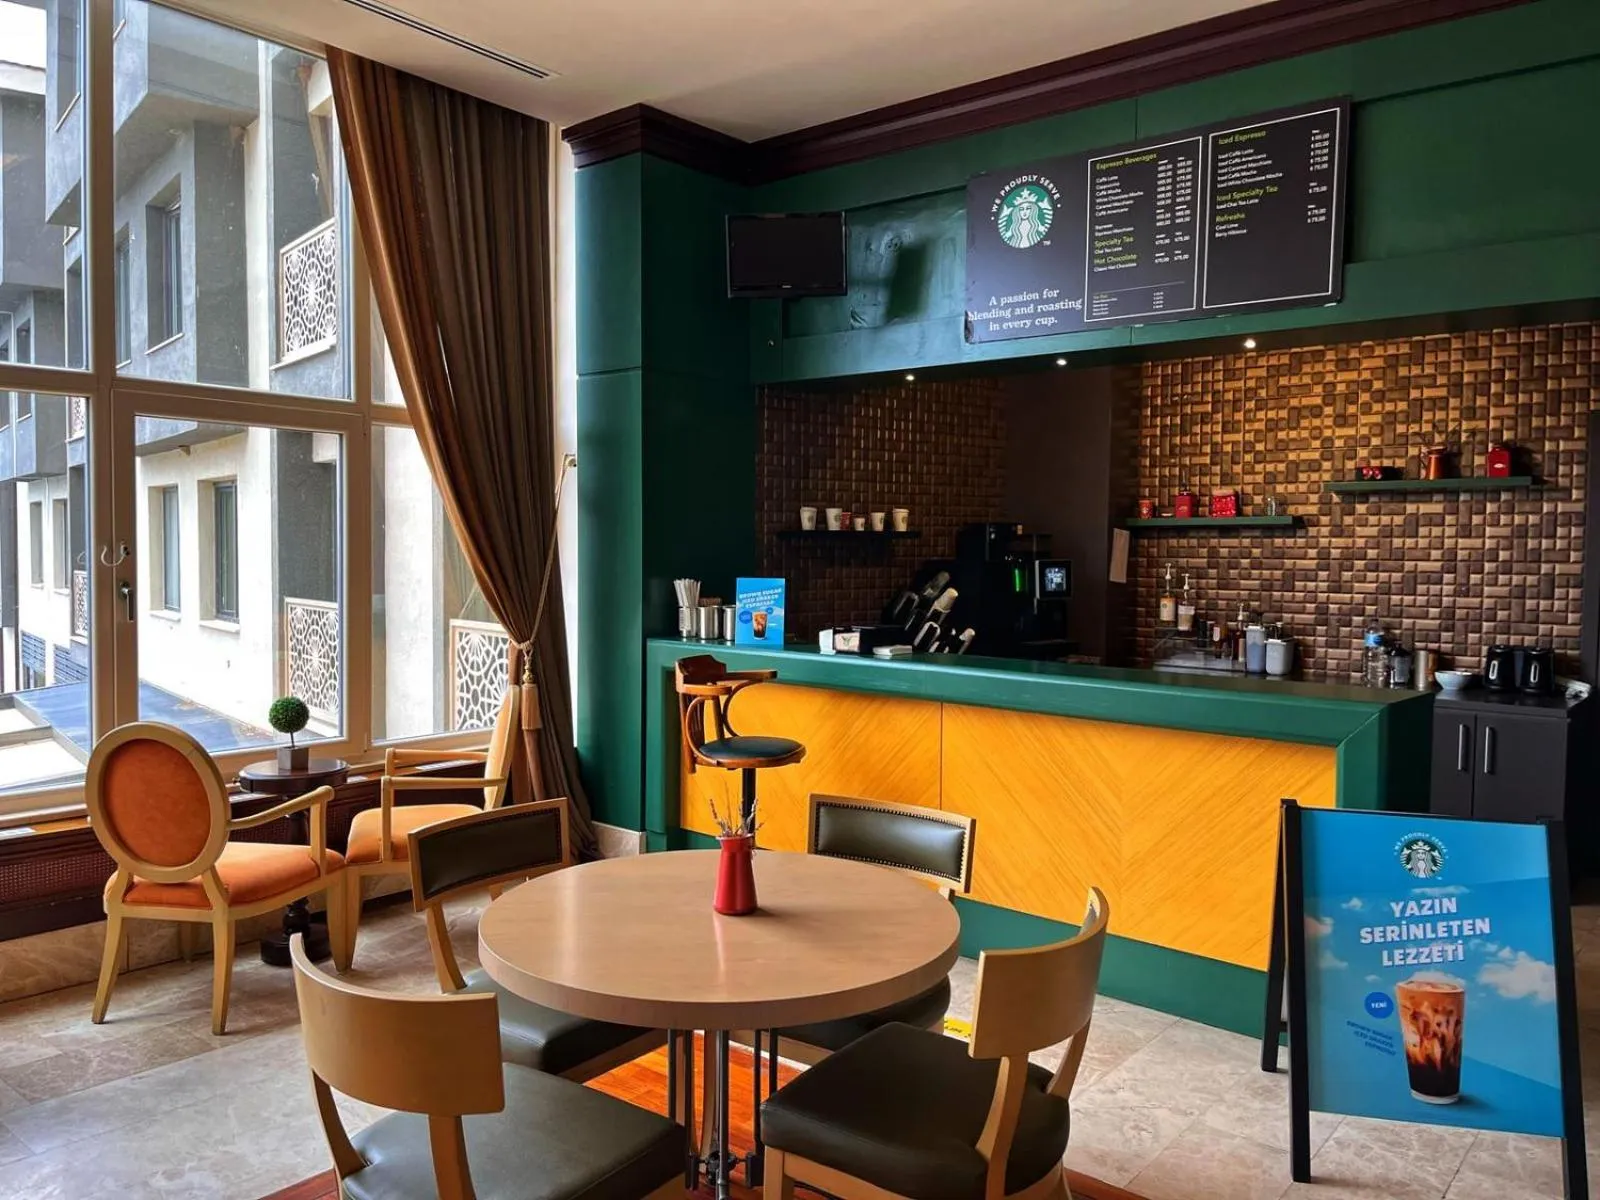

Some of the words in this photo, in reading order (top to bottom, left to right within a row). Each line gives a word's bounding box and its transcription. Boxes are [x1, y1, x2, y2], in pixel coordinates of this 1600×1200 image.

[992, 198, 1001, 213] WE
[1000, 175, 1038, 197] PROUDLY
[1040, 176, 1061, 201] SERVE
[989, 296, 998, 306] A
[1000, 291, 1039, 306] passion
[1042, 288, 1060, 299] for
[1014, 303, 1034, 315] and
[1037, 298, 1083, 313] roasting
[989, 321, 1000, 331] in
[1002, 319, 1033, 330] every
[1035, 316, 1059, 326] cup.
[1389, 897, 1458, 918] YAZIN
[1360, 918, 1491, 944] SERİNLETEN
[1382, 940, 1465, 967] LEZZETİ
